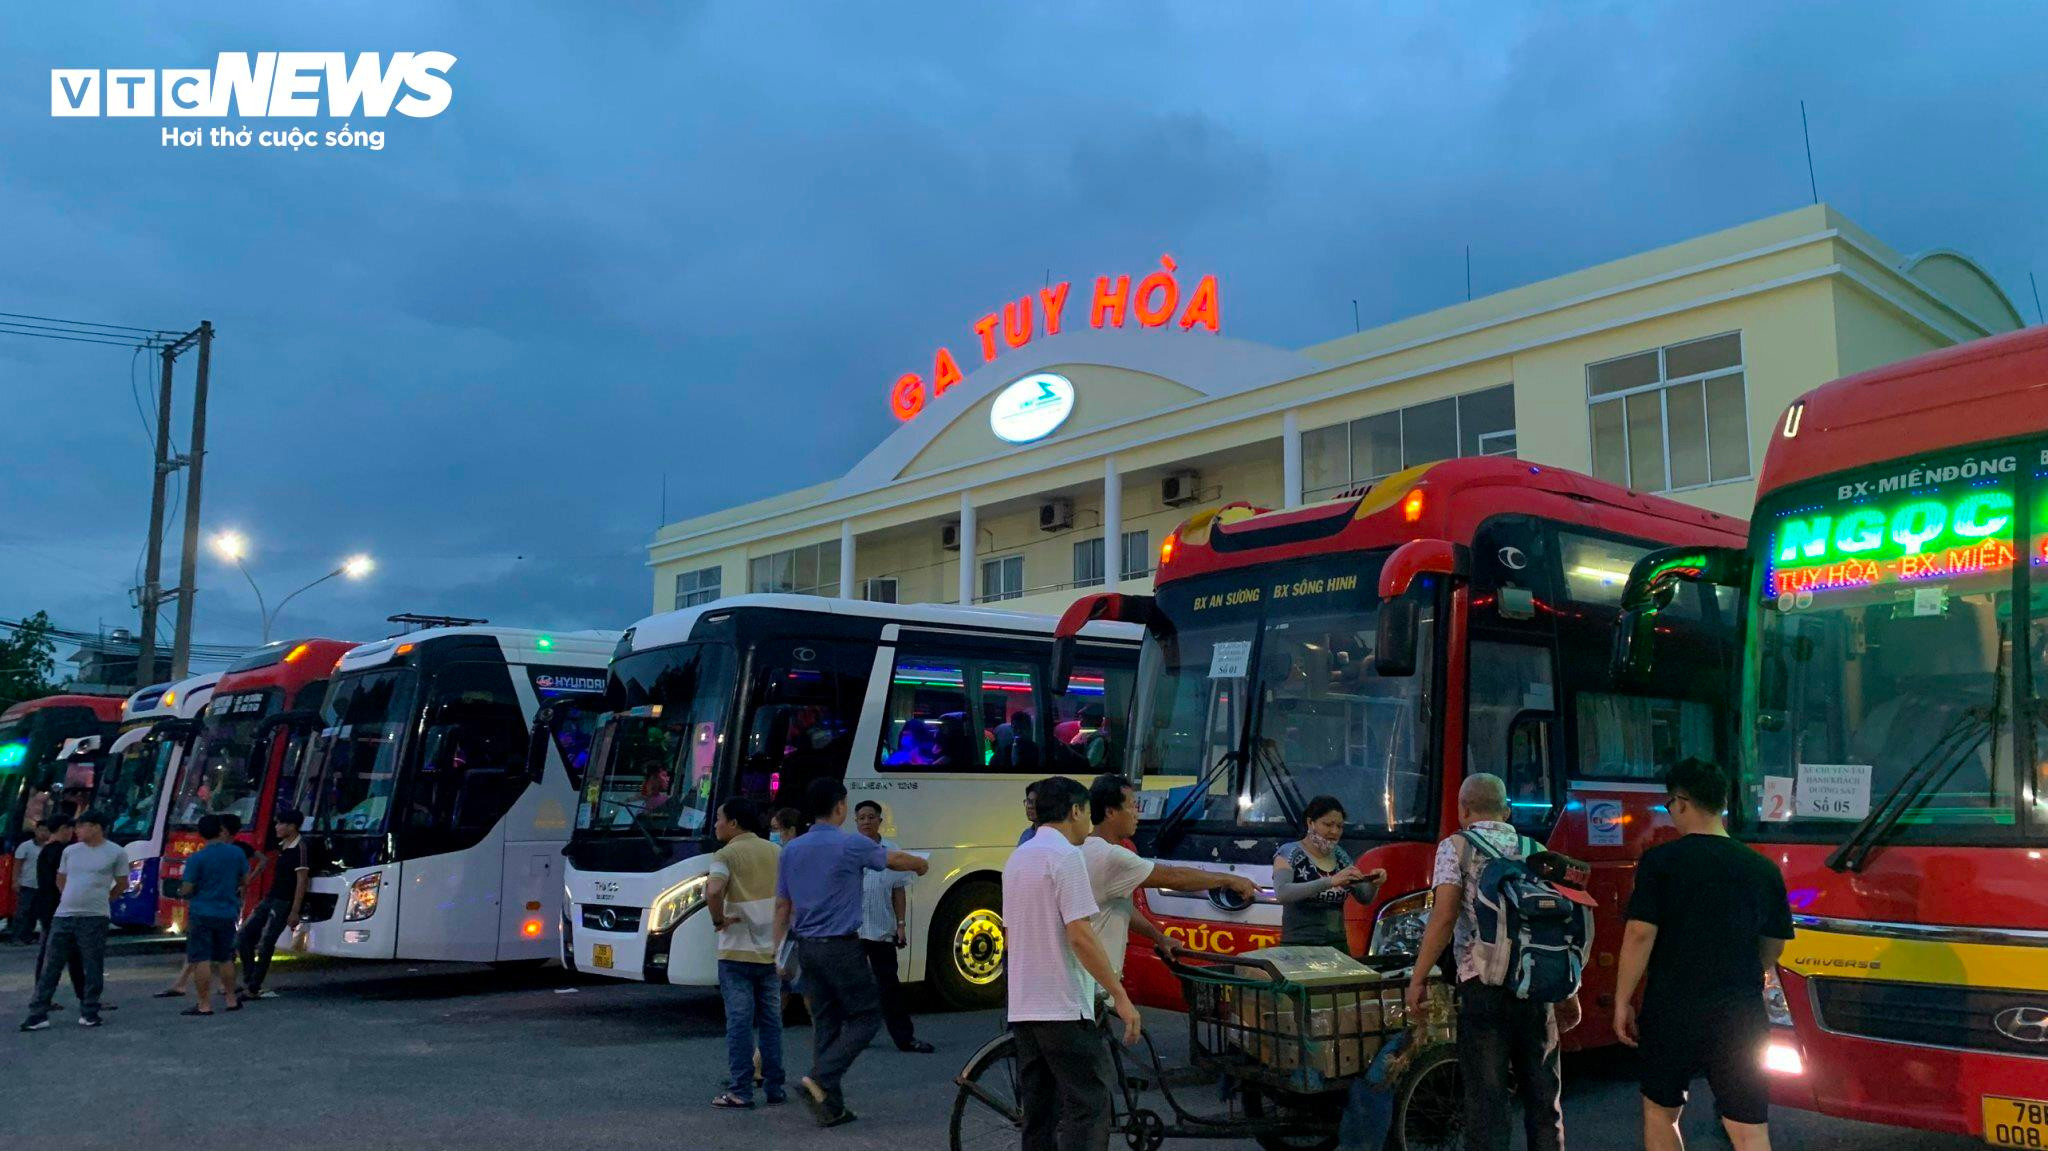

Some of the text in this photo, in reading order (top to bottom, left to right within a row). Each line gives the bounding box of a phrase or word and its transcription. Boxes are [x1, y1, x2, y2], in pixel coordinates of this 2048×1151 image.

[891, 253, 1220, 422] GA TUY HÒA
[1779, 568, 1822, 591] TUY
[1829, 558, 1880, 587] HÒA
[1273, 575, 1357, 599] BX SÔNG HINH
[1193, 597, 1207, 612] BX
[1209, 597, 1224, 609] AN
[554, 676, 606, 689] HYUNDAI
[1768, 795, 1784, 818] 2
[1813, 797, 1850, 813] Số 05
[1164, 924, 1235, 954] CÚC
[1794, 957, 1882, 970] UNIVERSE
